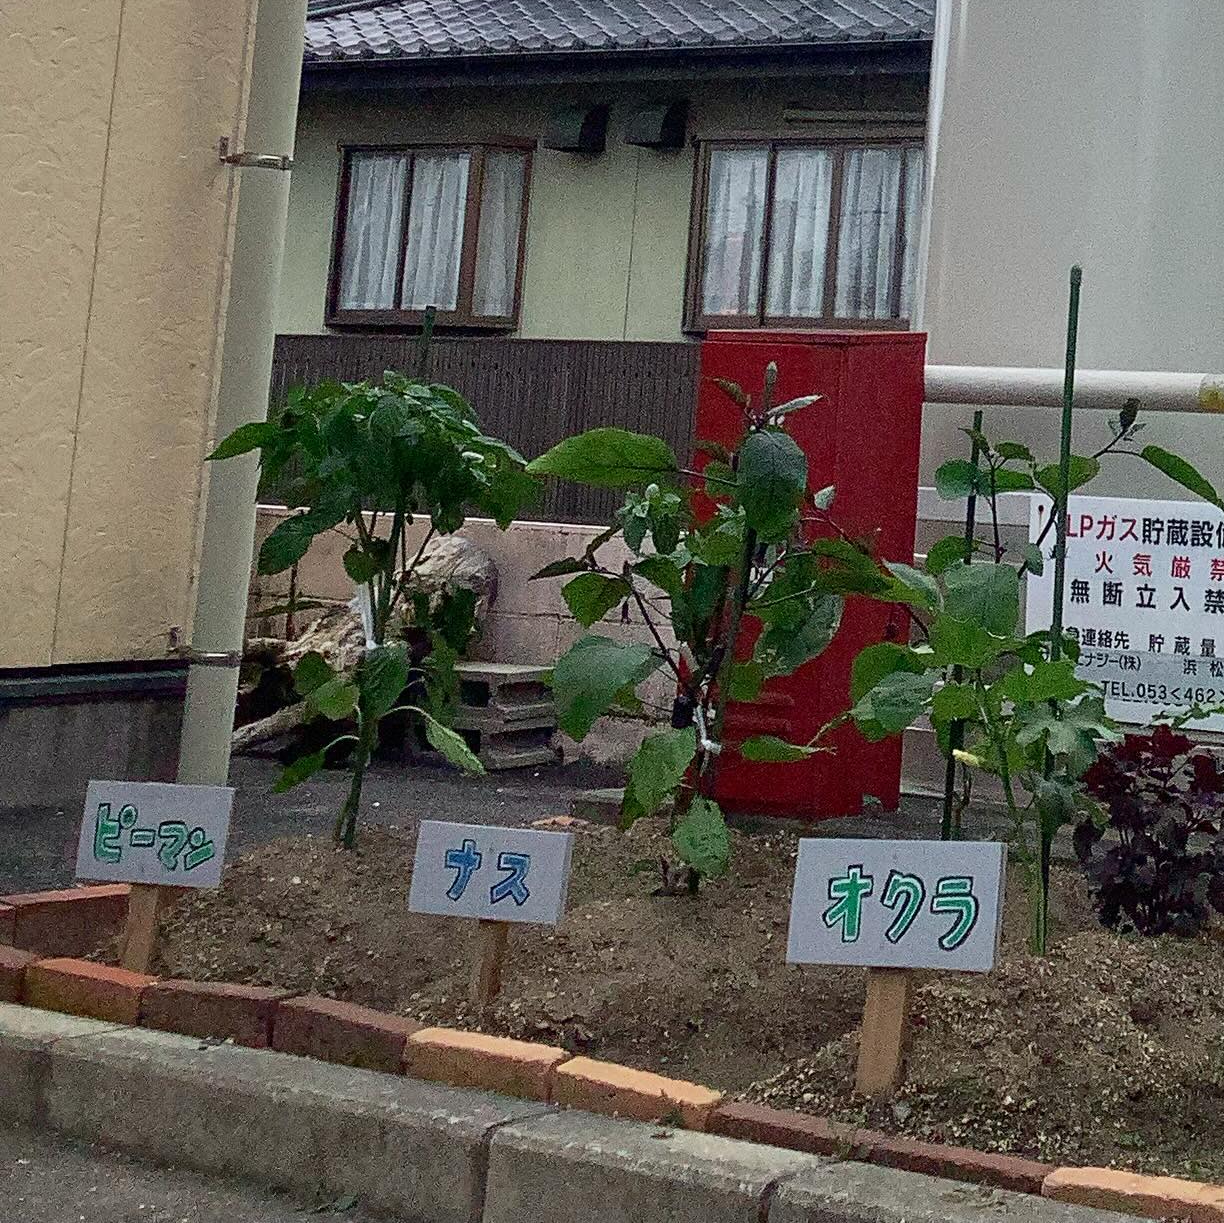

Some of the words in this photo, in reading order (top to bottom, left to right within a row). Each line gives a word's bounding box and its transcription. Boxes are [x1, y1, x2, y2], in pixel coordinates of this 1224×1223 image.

[1062, 626, 1130, 650] 急連絡先
[1148, 633, 1217, 658] 貯蔵量
[94, 803, 214, 872] ピーマン
[444, 839, 531, 907] ナス
[822, 864, 980, 952] オクラ
